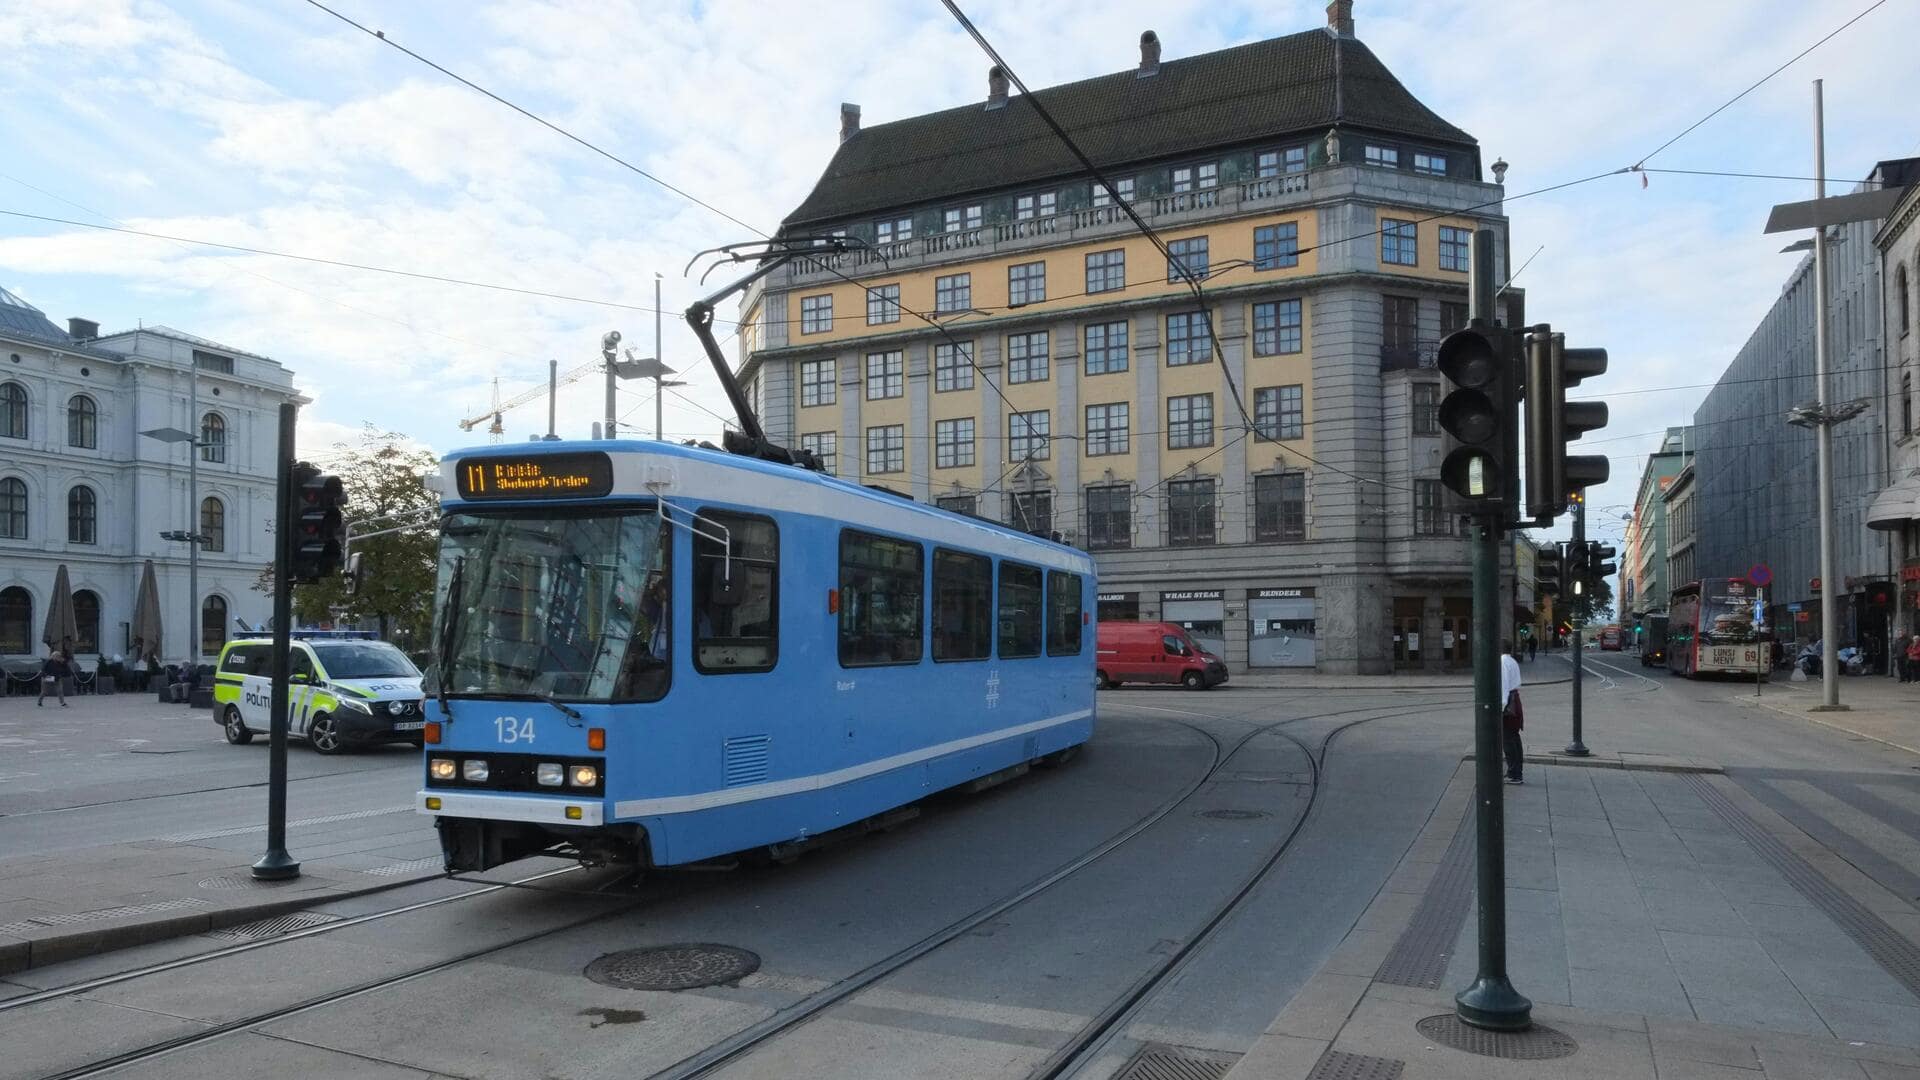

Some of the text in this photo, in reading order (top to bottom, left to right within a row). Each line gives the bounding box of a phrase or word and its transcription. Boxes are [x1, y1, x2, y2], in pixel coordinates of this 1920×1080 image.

[468, 464, 484, 492] 11
[1713, 656, 1735, 664] MENY
[246, 692, 270, 709] POLITI
[494, 716, 535, 744] 134
